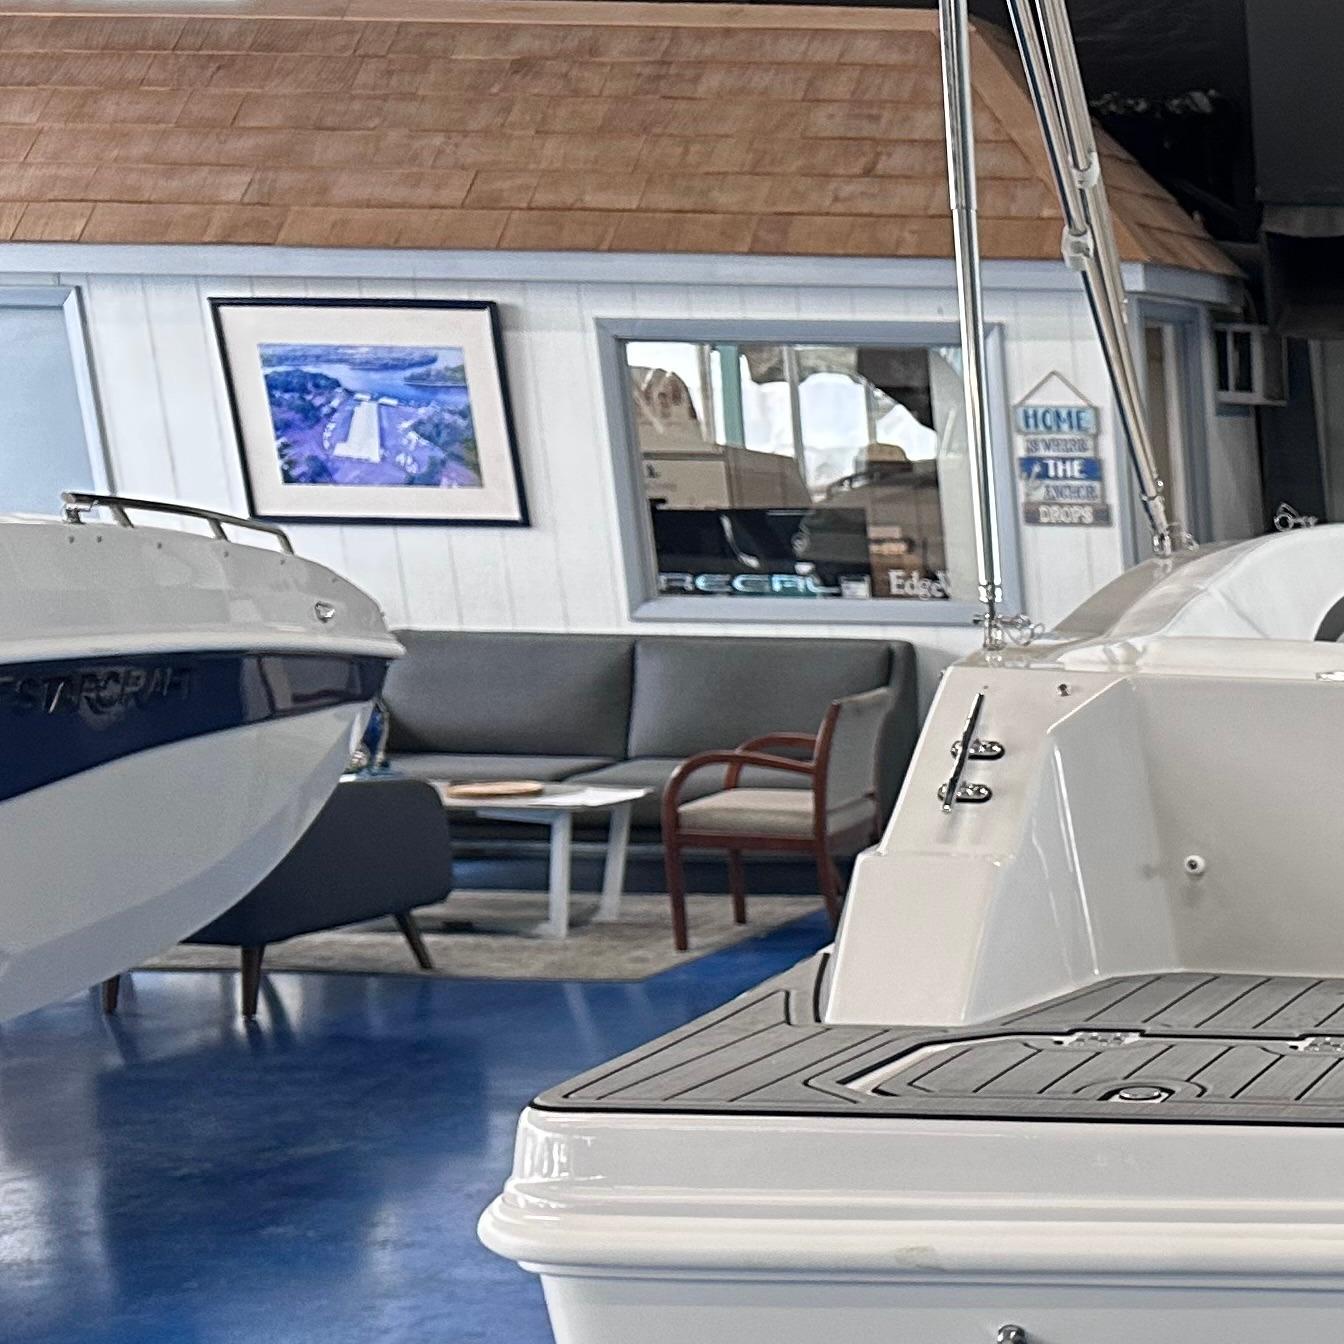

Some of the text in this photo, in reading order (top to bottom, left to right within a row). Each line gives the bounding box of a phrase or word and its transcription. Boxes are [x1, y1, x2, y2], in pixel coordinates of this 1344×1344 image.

[1022, 408, 1087, 430] HOME
[1042, 459, 1085, 479] THE
[1039, 504, 1094, 524] DROPS
[658, 572, 840, 594] REGAL
